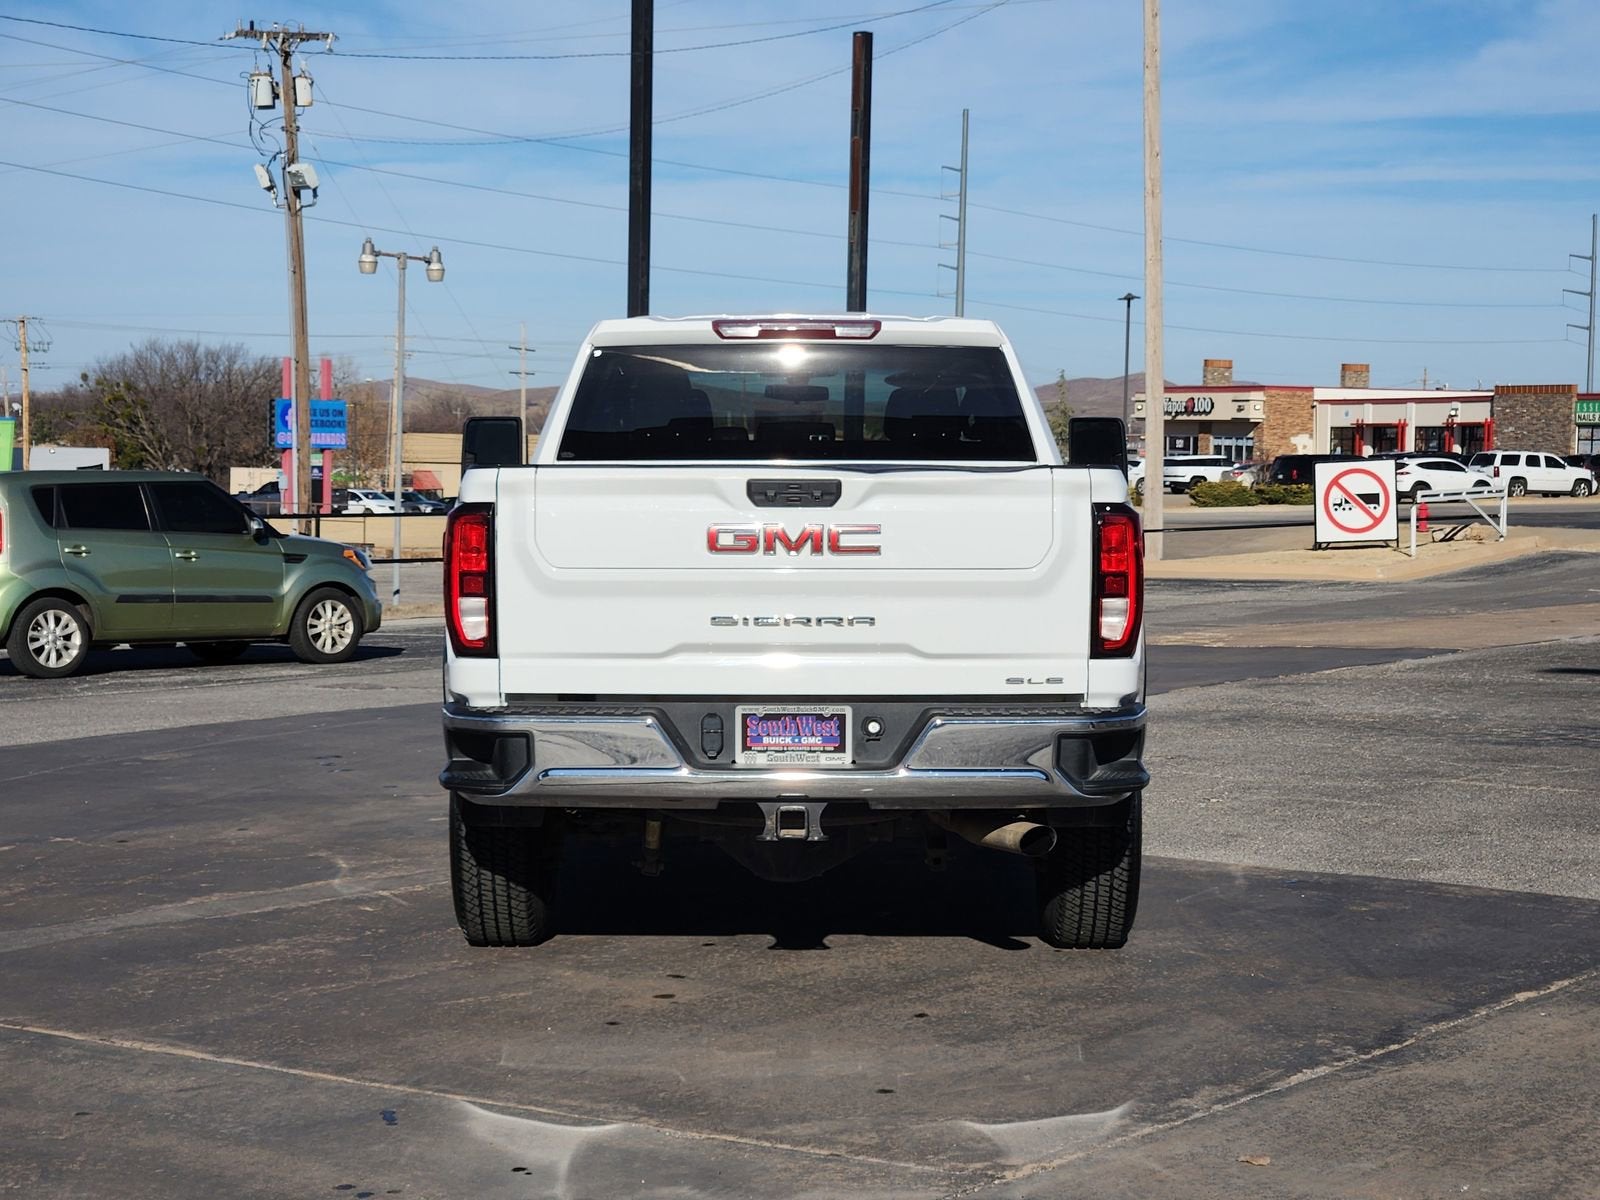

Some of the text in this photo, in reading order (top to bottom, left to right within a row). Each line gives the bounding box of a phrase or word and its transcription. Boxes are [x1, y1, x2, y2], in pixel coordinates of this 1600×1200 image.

[1193, 398, 1213, 413] 100
[319, 408, 330, 417] US
[332, 408, 344, 417] ON
[1578, 414, 1596, 422] NAILS
[707, 522, 881, 556] GMC
[710, 616, 876, 627] SIERRA
[1005, 677, 1064, 685] SLE
[747, 715, 840, 736] SouthWest
[762, 736, 823, 744] BUICK GMC
[767, 753, 820, 763] SouthWest
